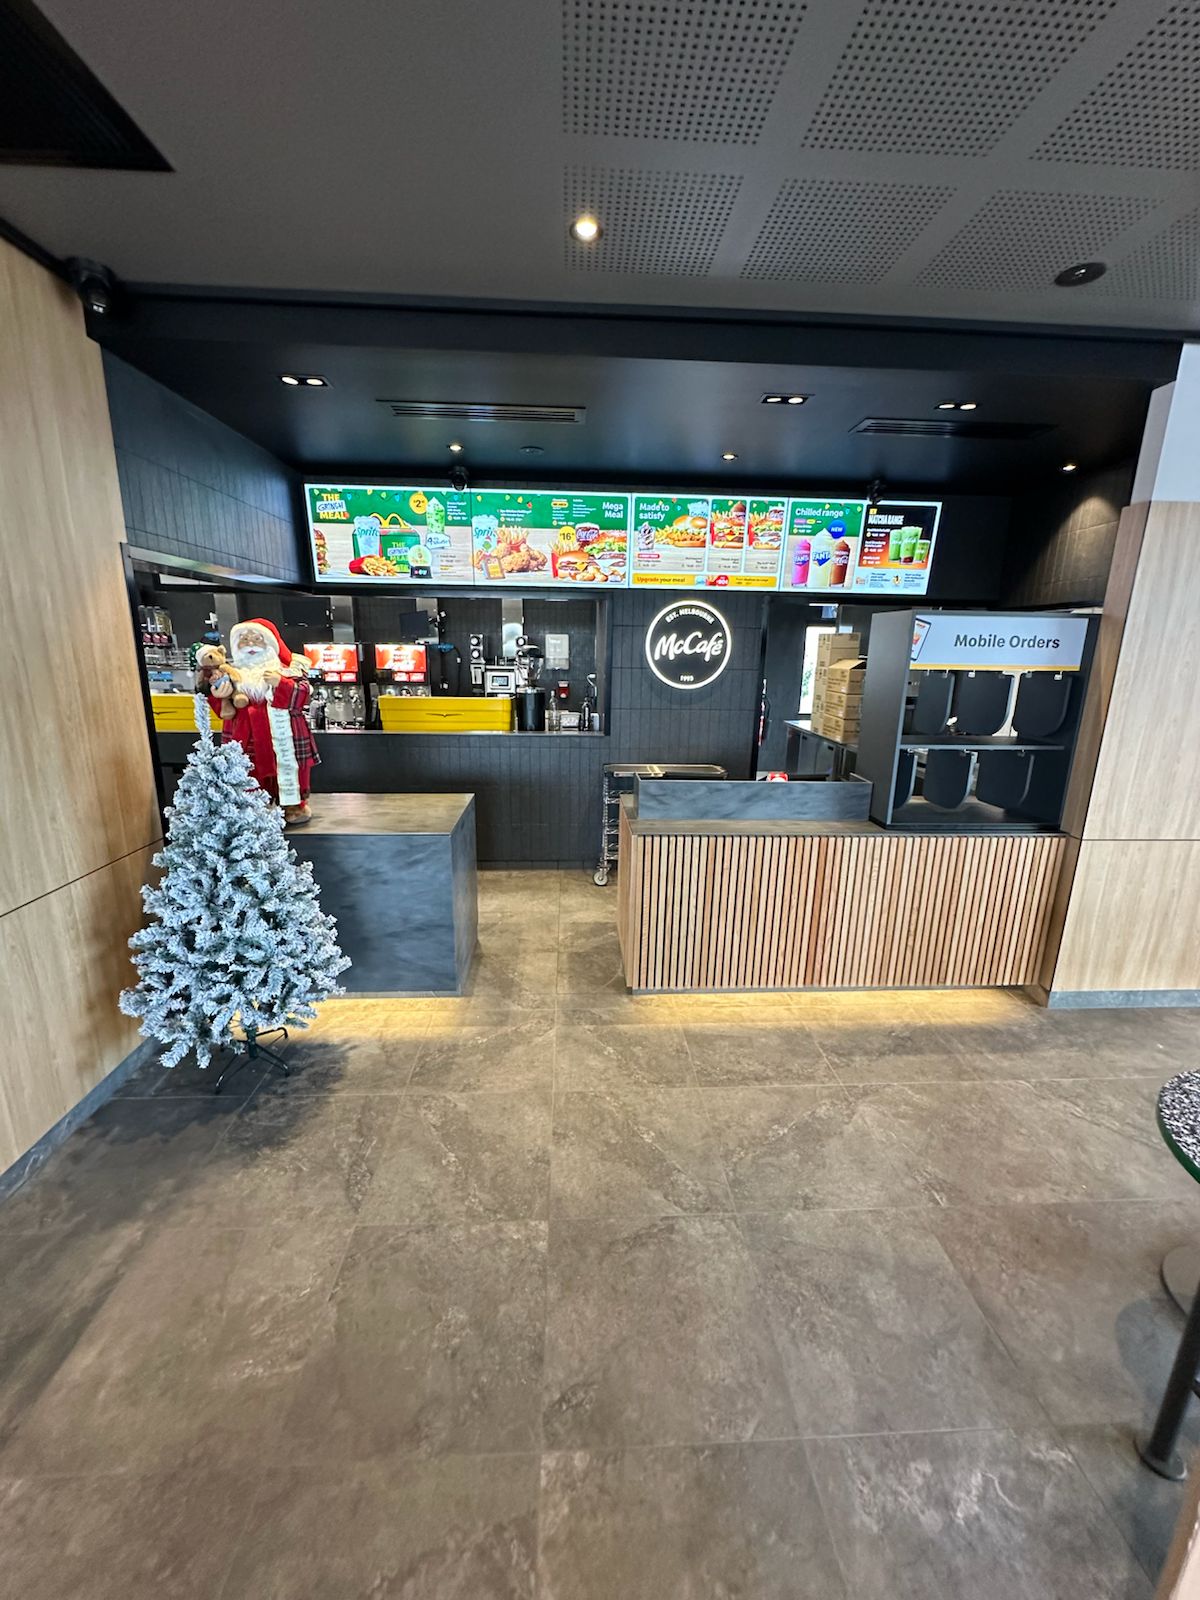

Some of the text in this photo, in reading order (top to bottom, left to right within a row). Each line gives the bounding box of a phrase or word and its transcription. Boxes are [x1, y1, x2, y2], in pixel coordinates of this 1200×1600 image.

[321, 493, 340, 501] THE
[602, 501, 624, 512] Mega
[640, 503, 660, 511] Made
[320, 511, 346, 520] MEAL
[605, 510, 624, 519] Meal
[639, 512, 665, 521] satisfy
[795, 508, 844, 518] Chilled range
[637, 576, 659, 584] Upgrade
[953, 633, 1060, 649] Mobile Orders
[654, 631, 724, 662] McCafé
